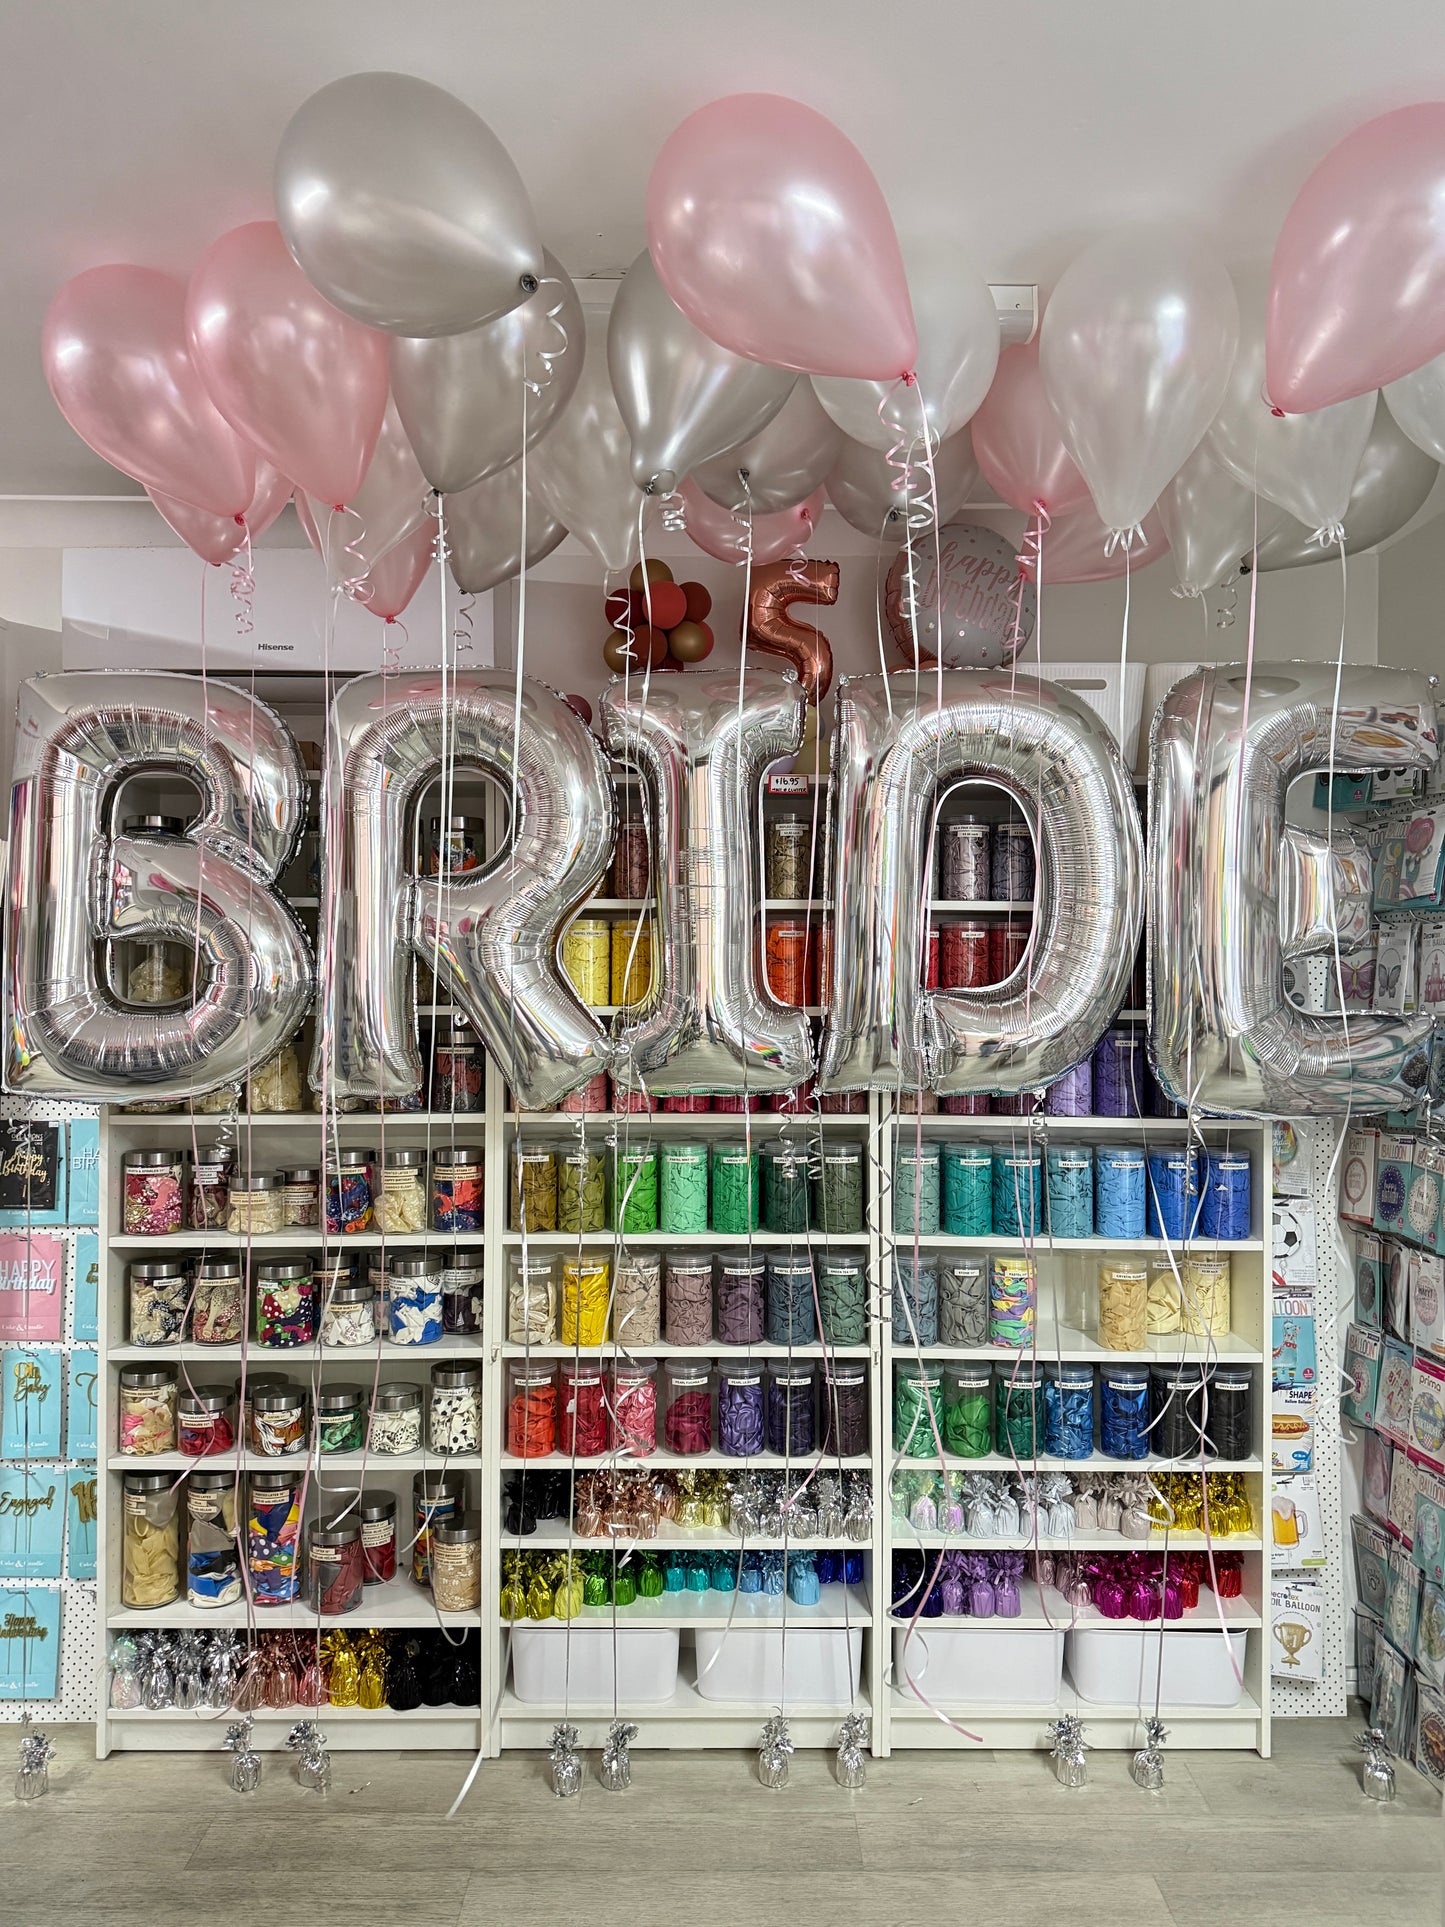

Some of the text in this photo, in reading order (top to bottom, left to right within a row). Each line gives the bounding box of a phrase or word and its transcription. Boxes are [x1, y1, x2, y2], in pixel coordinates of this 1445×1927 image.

[257, 643, 294, 651] Hisense
[776, 777, 801, 786] $16.95
[0, 1260, 55, 1279] HAPPY
[1350, 1334, 1375, 1358] BALLOON
[1419, 1375, 1441, 1391] prima
[1289, 1390, 1312, 1399] SHAPE
[1399, 1456, 1418, 1477] pima
[0, 1485, 56, 1517] Engaged
[1271, 1598, 1321, 1613] OIL BALLOON
